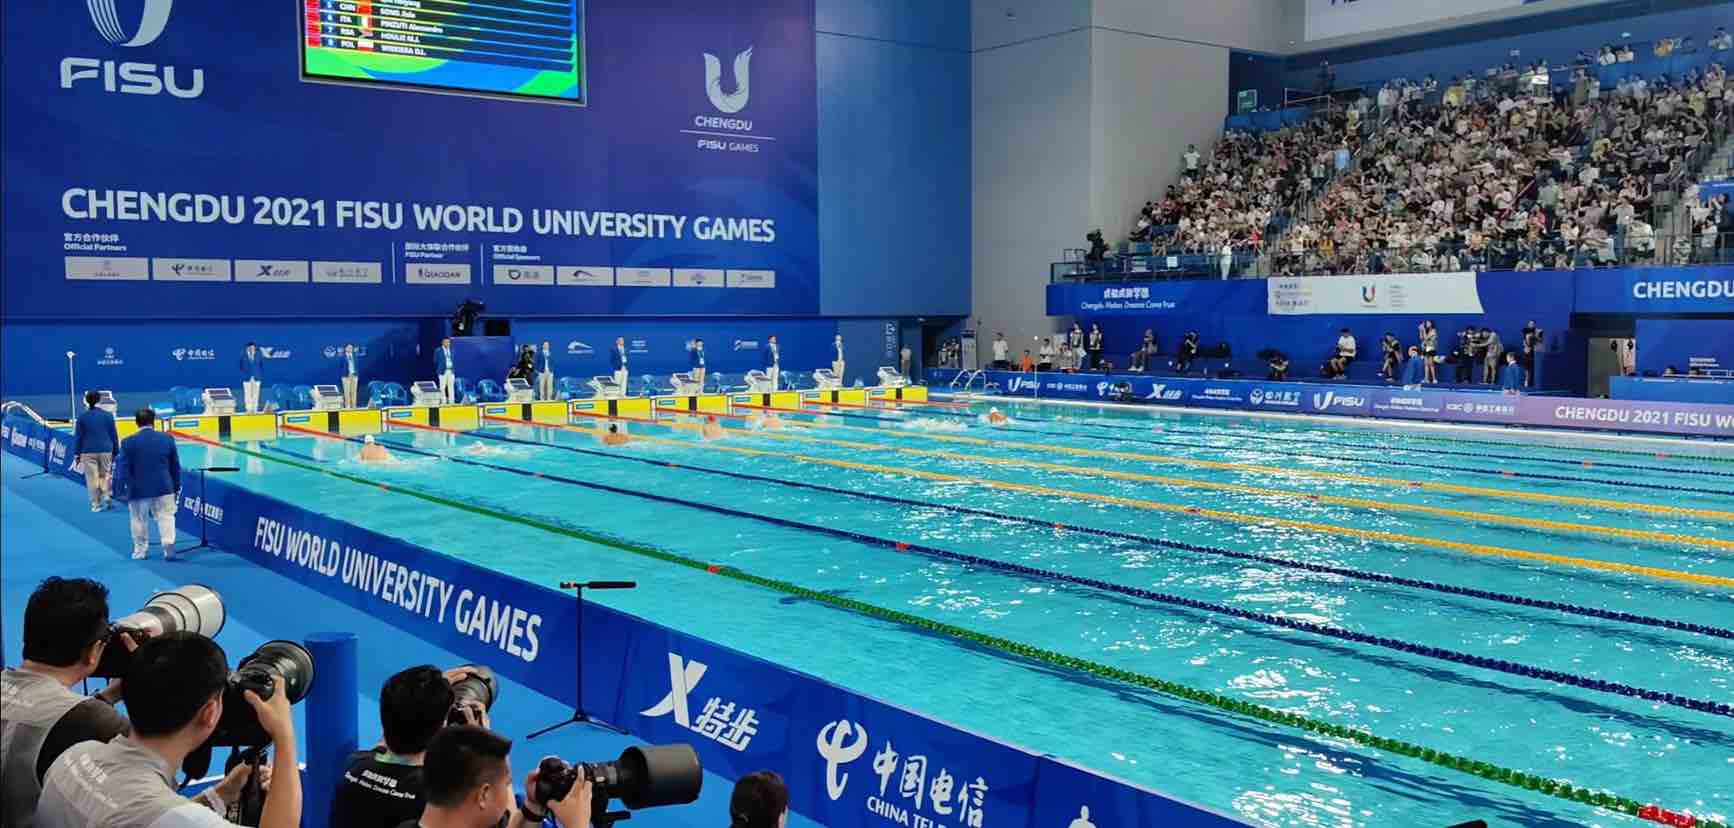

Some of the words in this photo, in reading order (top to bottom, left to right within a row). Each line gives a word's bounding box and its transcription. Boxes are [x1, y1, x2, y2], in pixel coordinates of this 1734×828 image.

[60, 57, 204, 98] FISU
[695, 116, 752, 131] CHENGDU
[697, 140, 726, 150] FISU
[729, 143, 760, 152] GAMES
[62, 188, 245, 224] CHENGDU
[253, 197, 325, 227] 2021
[337, 200, 403, 230] FISU
[413, 204, 523, 233] WORLD
[533, 209, 687, 239] UNIVERSITY
[694, 216, 775, 243] GAMES
[64, 243, 93, 251] Official
[95, 243, 127, 251] Partners
[1633, 280, 1734, 298] CHENGDU
[1333, 396, 1364, 406] FISU
[1555, 406, 1629, 422] CHENGDU
[1632, 410, 1668, 424] 2021
[1674, 412, 1712, 426] FISU
[255, 516, 285, 556] FISU
[285, 529, 339, 576] WORLD
[343, 547, 455, 623] UNIVERSITY
[455, 590, 542, 662] GAMES
[691, 697, 759, 752] 特步
[873, 740, 989, 828] 中国电信
[867, 796, 909, 827] CHINA
[913, 813, 947, 828] TEL
